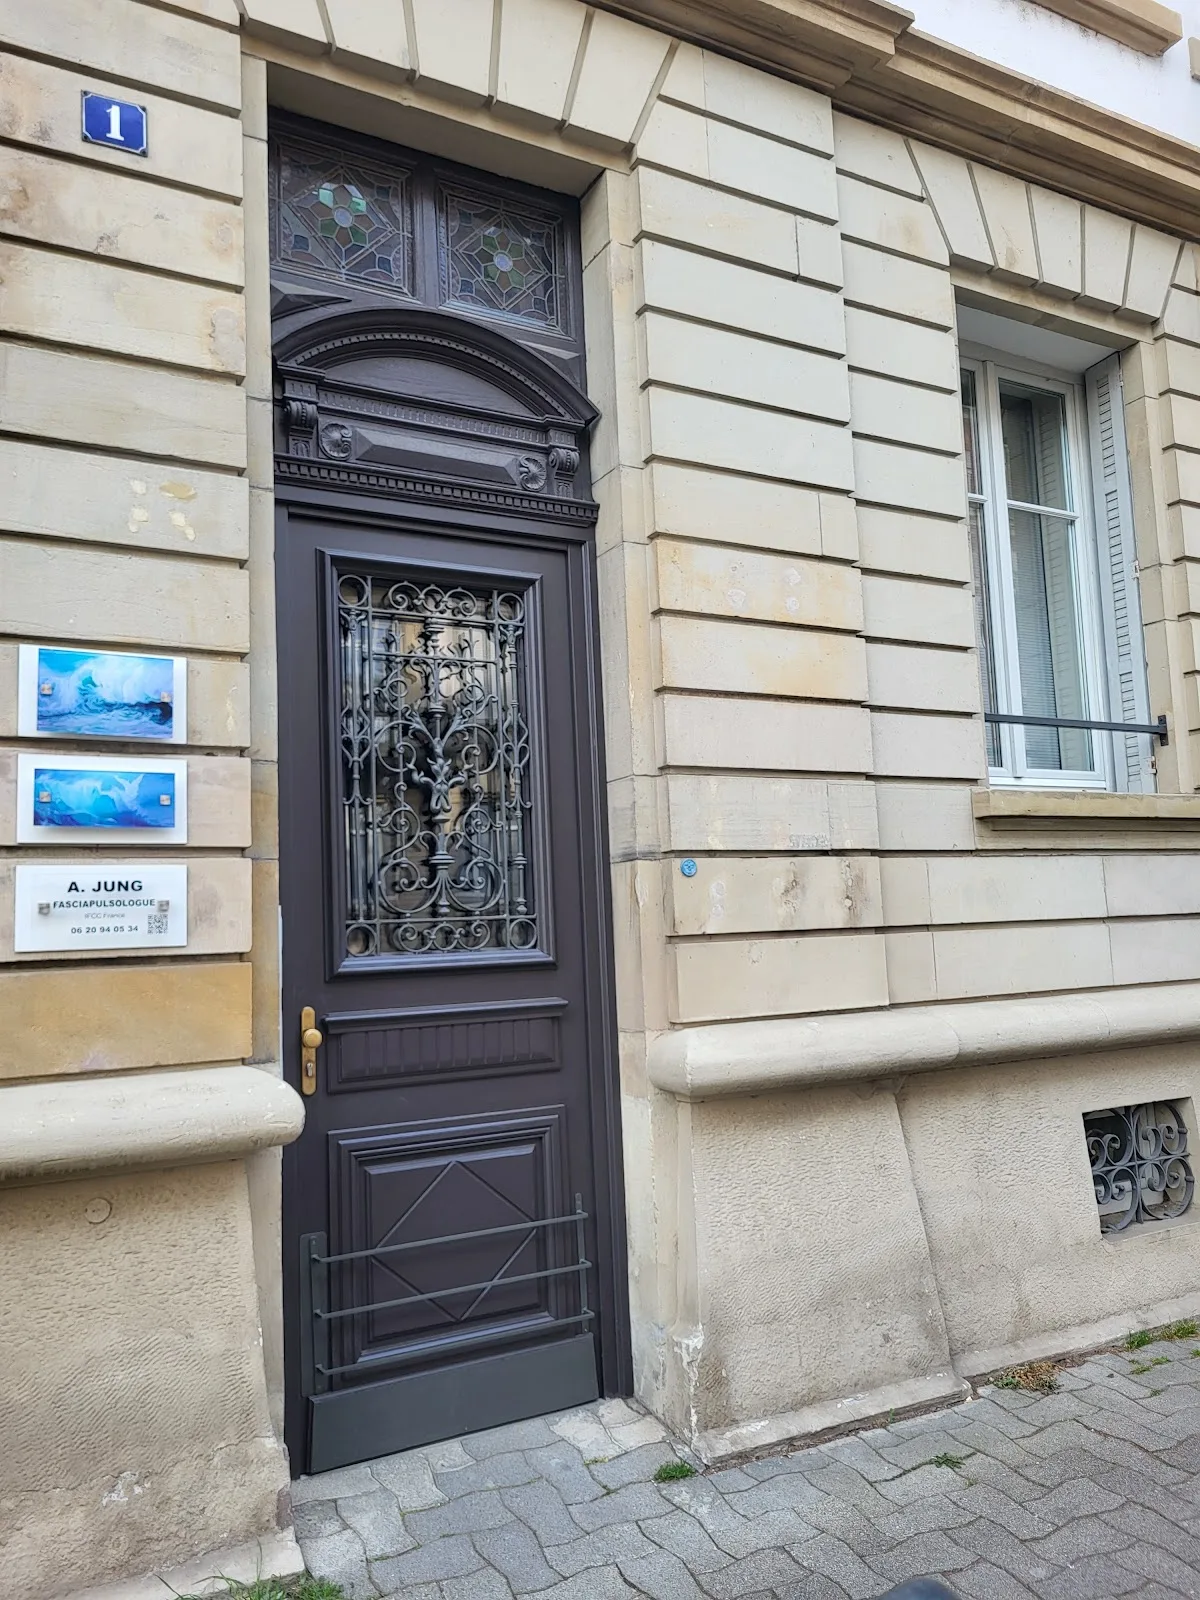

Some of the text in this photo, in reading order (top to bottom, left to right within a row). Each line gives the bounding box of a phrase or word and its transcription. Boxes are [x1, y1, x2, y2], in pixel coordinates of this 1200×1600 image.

[106, 105, 125, 141] 1
[67, 880, 143, 893] A. JUNG
[53, 898, 156, 909] FASCIAPULSOLOGUE
[85, 926, 97, 934] 20
[113, 925, 125, 933] 05
